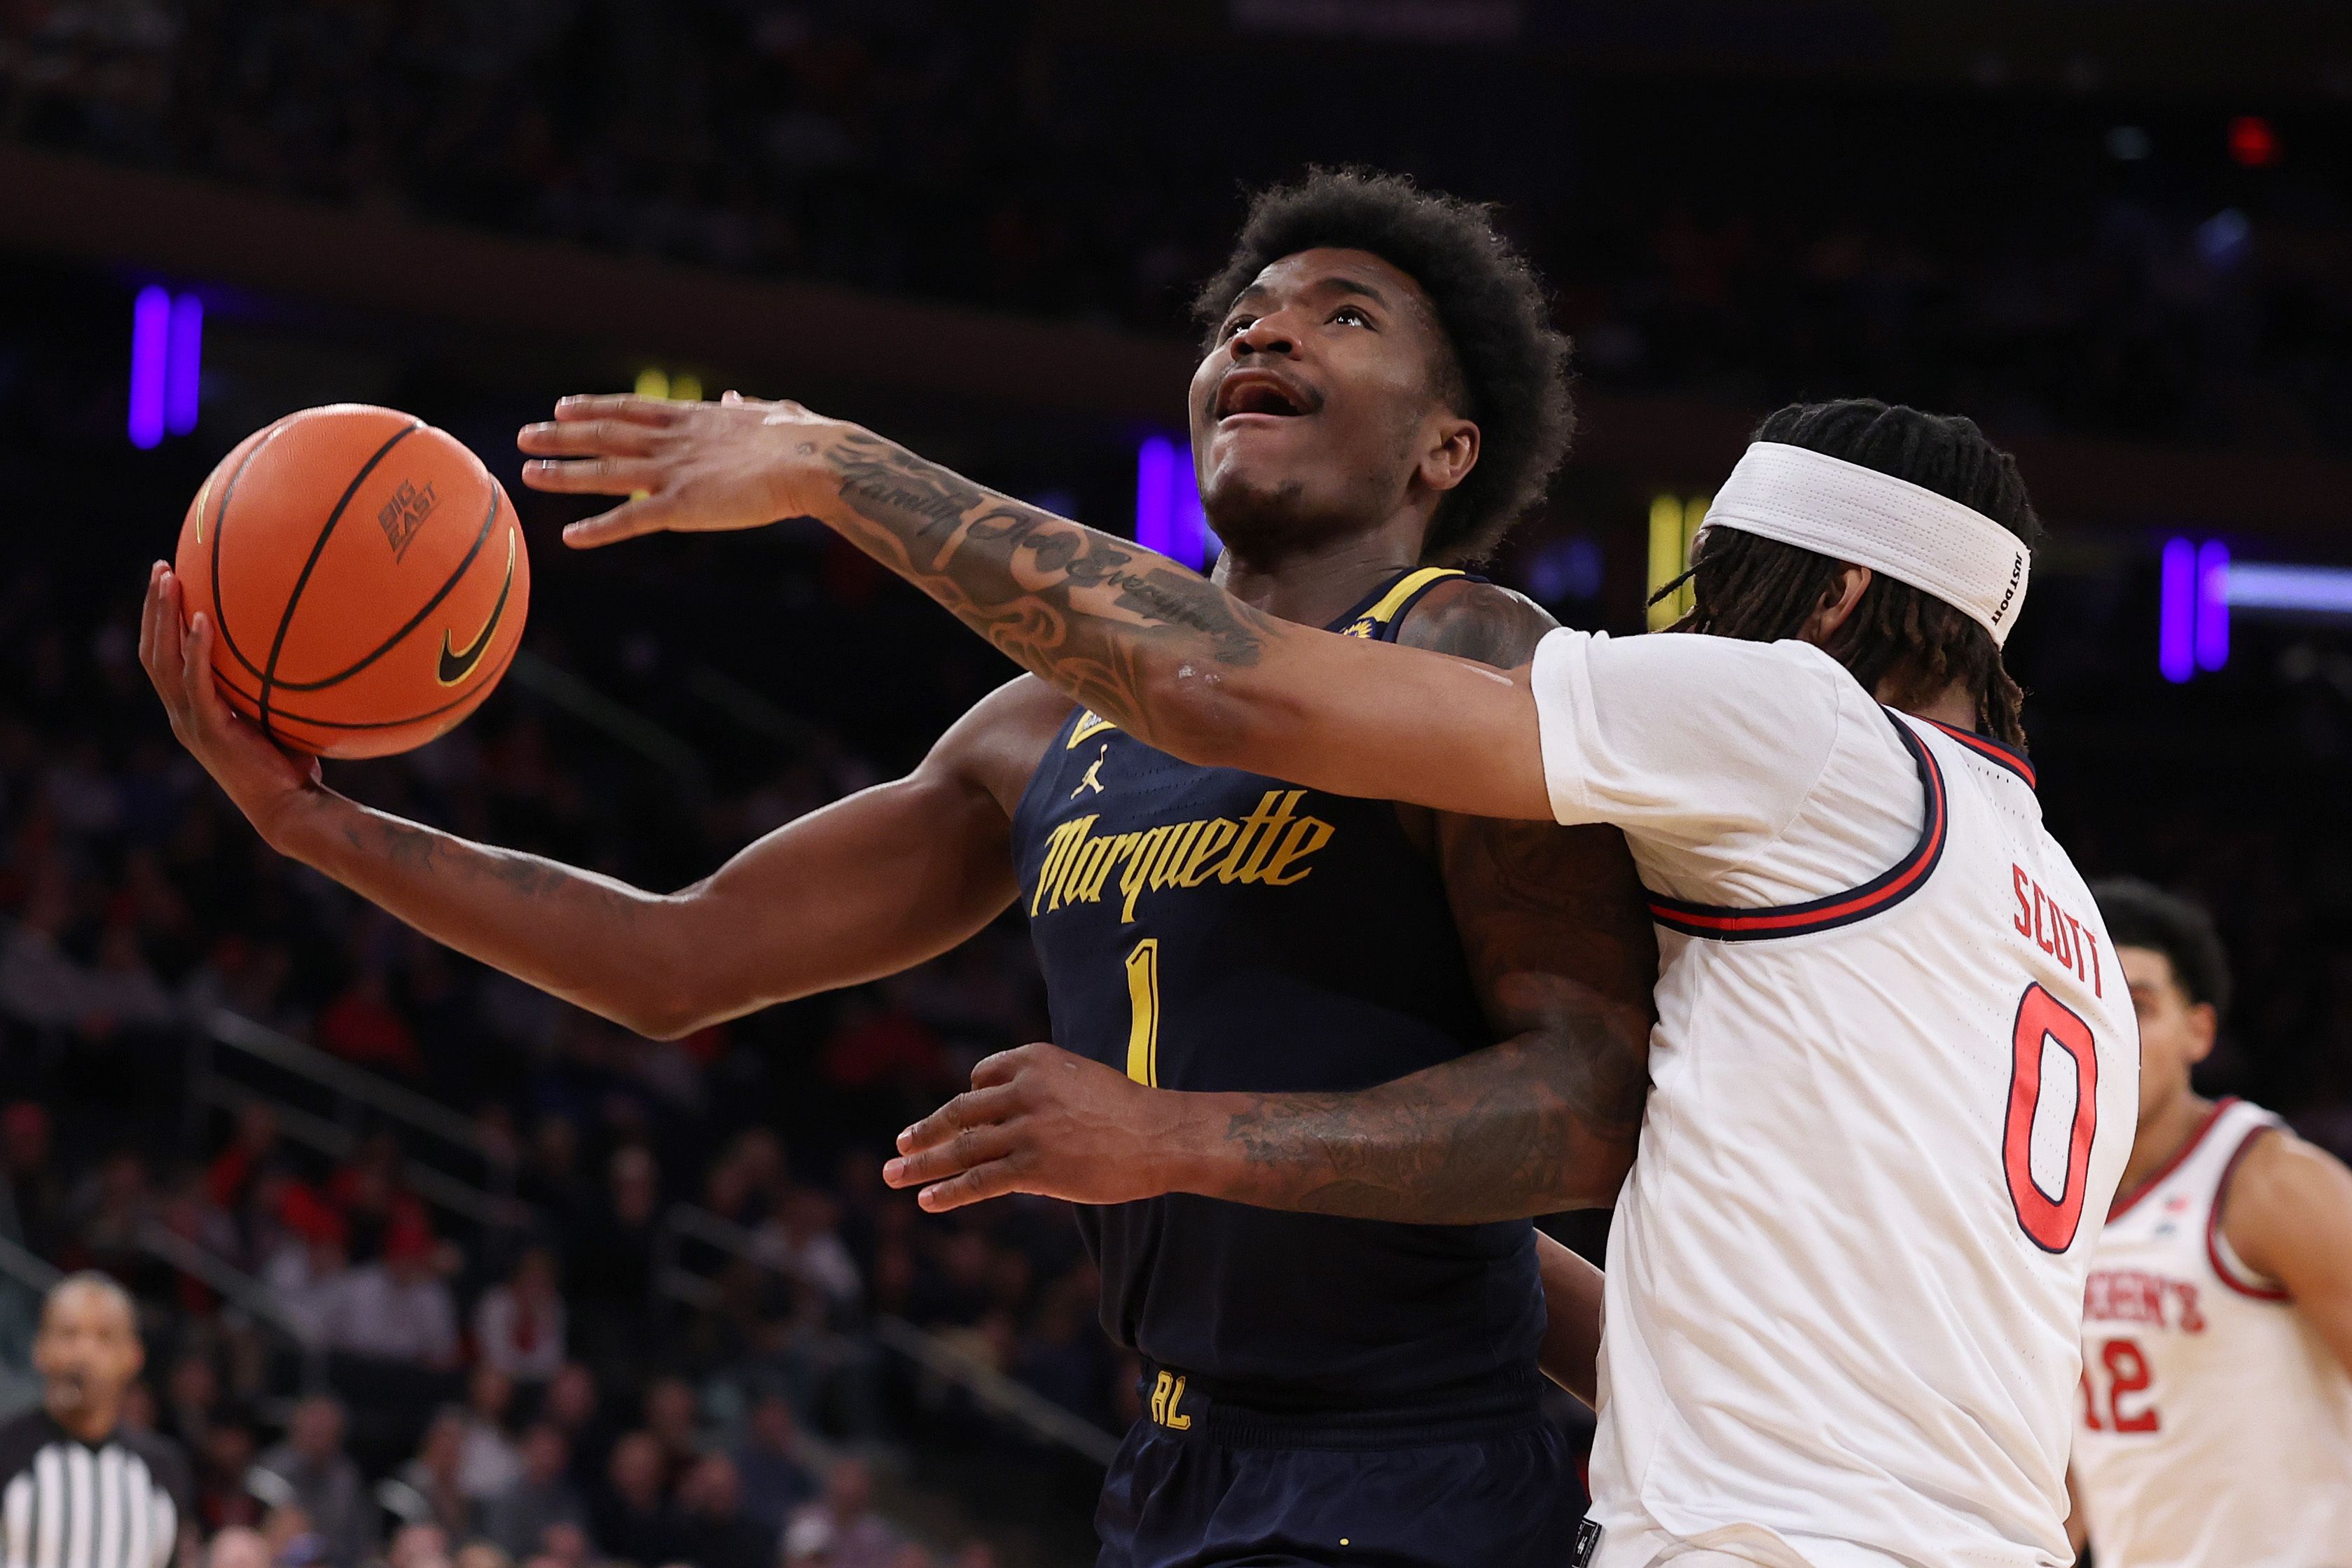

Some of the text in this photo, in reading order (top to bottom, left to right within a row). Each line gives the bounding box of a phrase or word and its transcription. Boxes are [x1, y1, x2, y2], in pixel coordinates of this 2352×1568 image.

[378, 479, 415, 531] BIG
[389, 480, 437, 553] EAST
[2009, 550, 2023, 590] JUST
[1030, 789, 1336, 924] Marquette
[2012, 862, 2102, 999] SCOTT
[1125, 937, 1160, 1089] 1
[2002, 981, 2098, 1255] 0
[1151, 1370, 1191, 1431] AL
[2081, 1339, 2160, 1433] 12
